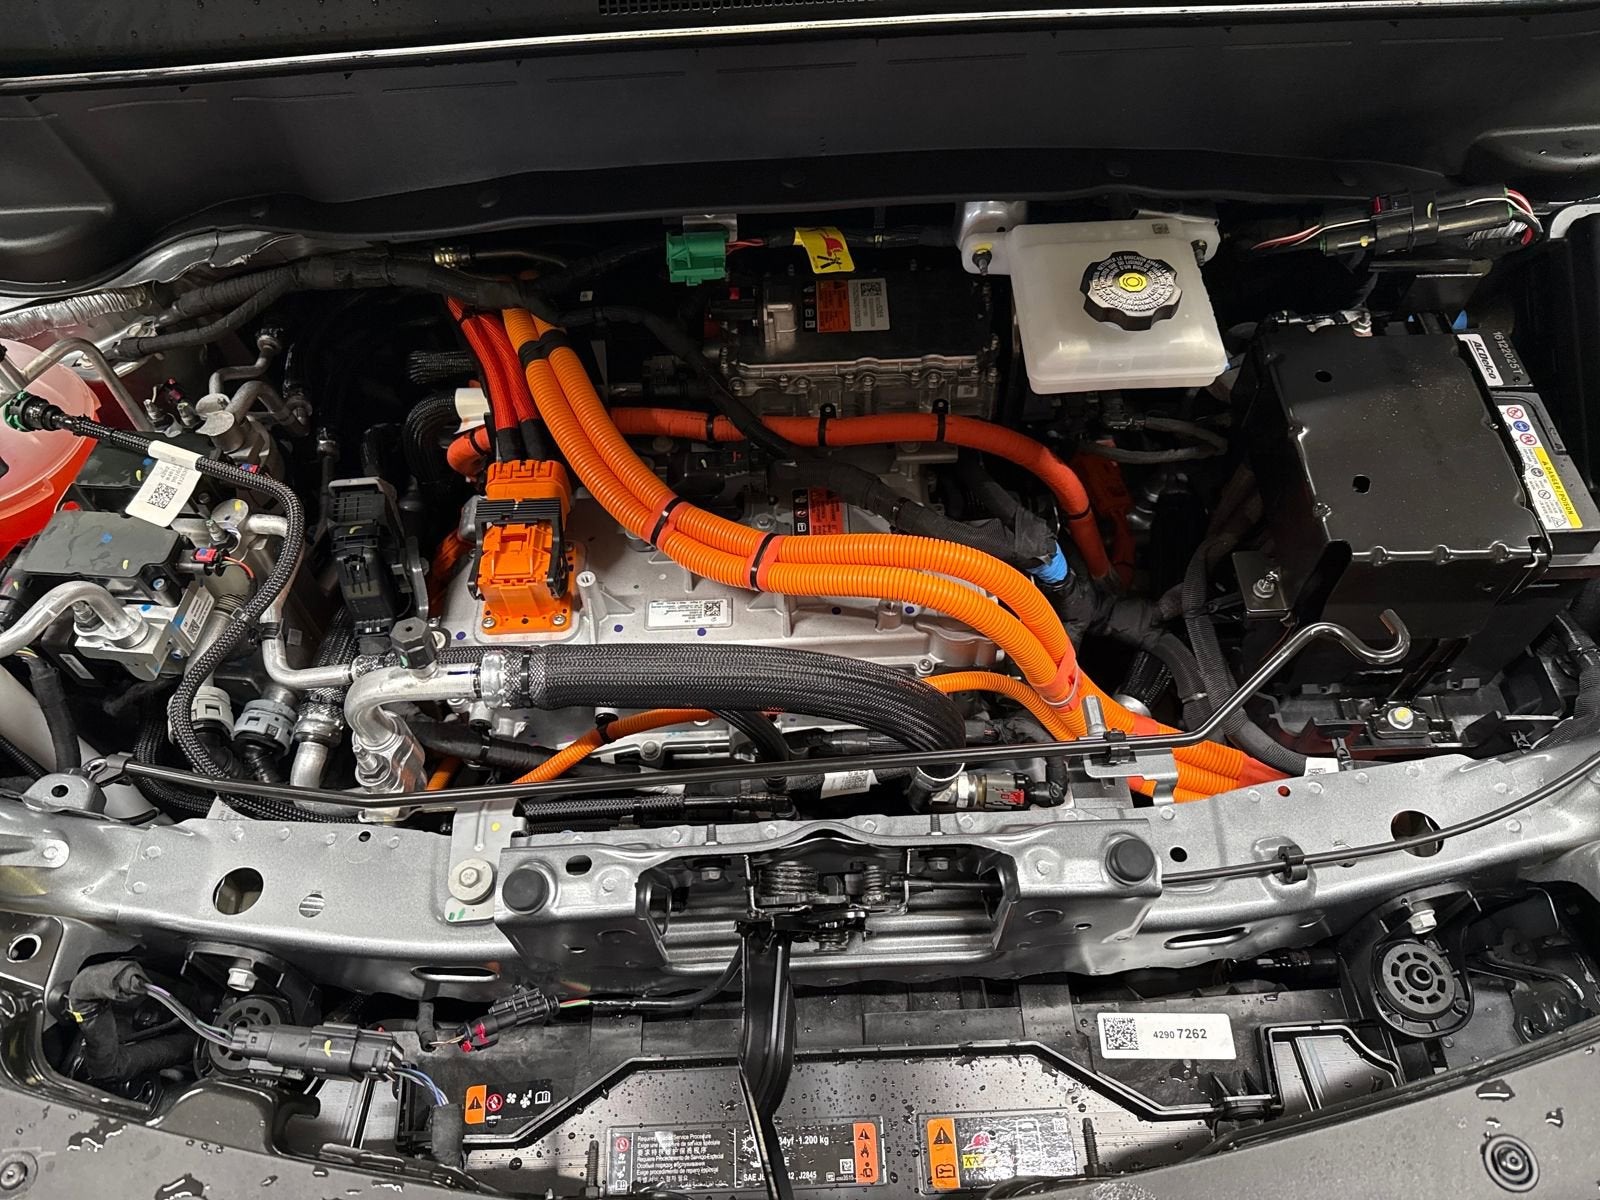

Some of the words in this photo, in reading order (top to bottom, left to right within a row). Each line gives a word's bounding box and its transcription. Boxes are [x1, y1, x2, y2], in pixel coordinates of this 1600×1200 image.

[1472, 340, 1497, 380] ACDelco
[1492, 331, 1524, 375] 16122025T
[1545, 466, 1562, 490] DANGER
[1558, 493, 1575, 515] POISON
[1153, 1030, 1175, 1039] 4290
[1176, 1028, 1208, 1039] 7262
[819, 1135, 830, 1146] kg
[743, 1173, 757, 1181] SAE
